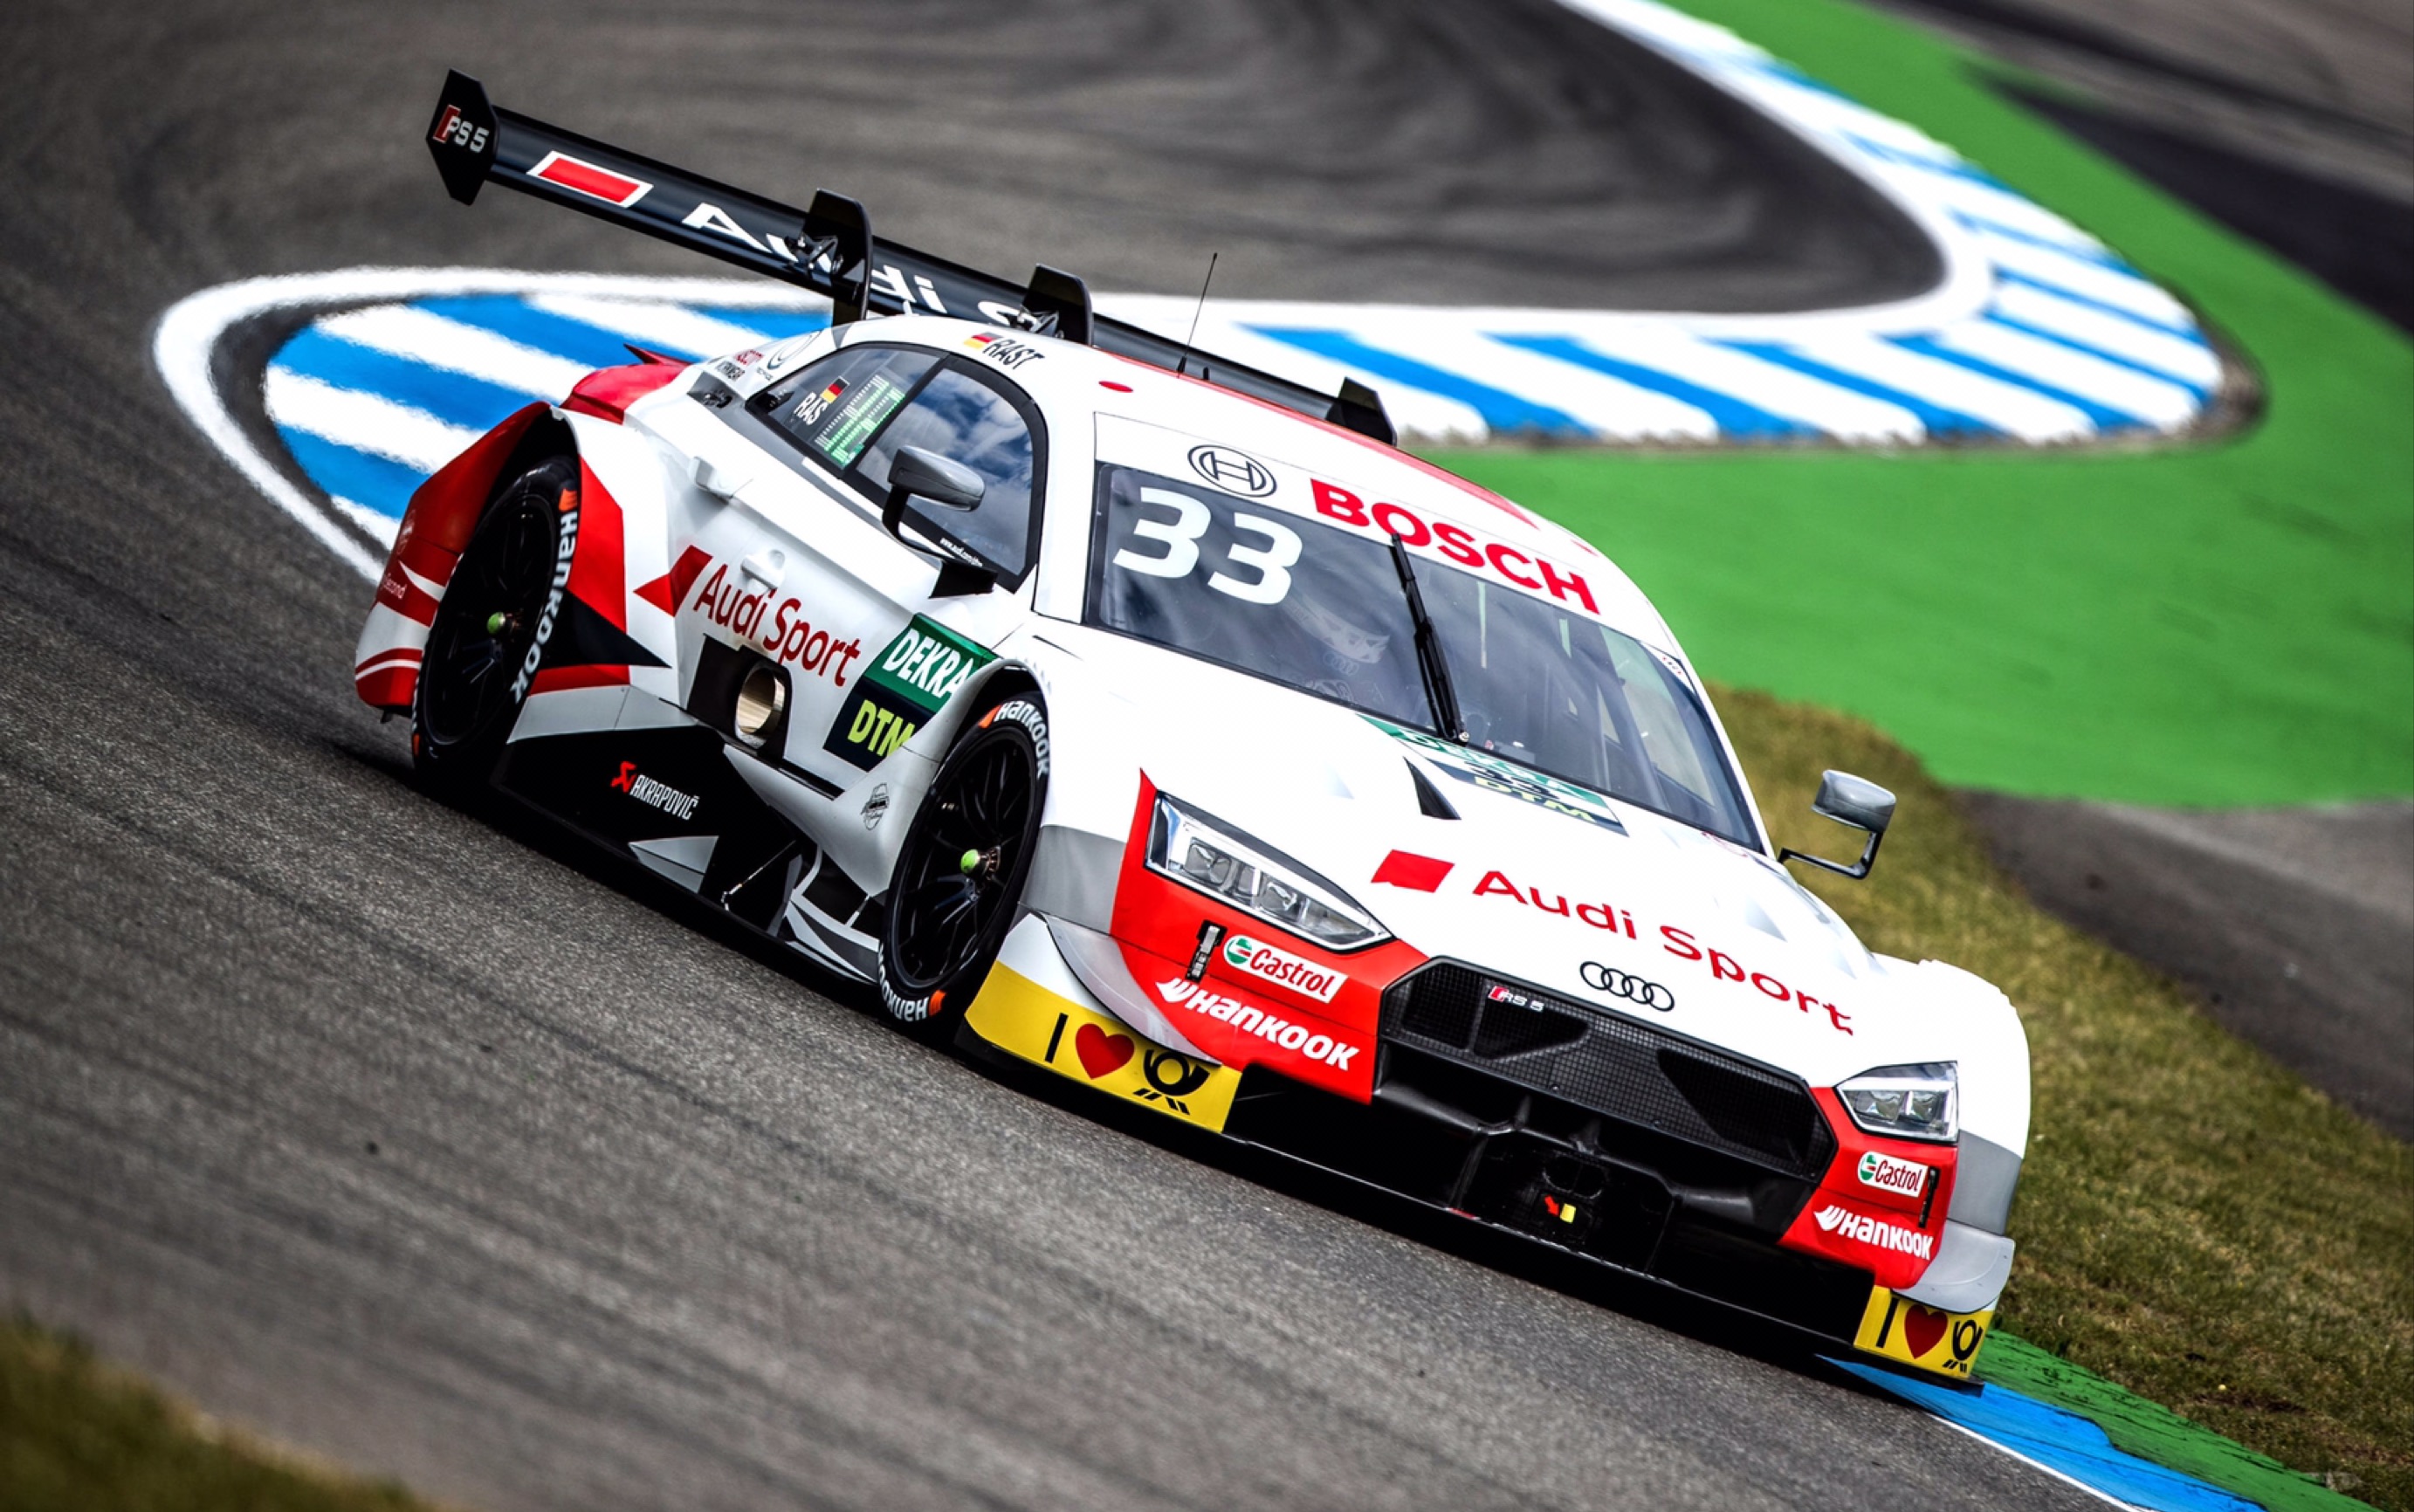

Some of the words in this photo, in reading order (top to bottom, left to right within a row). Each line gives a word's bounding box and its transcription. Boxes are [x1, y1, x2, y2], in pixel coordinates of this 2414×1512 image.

[982, 339, 1046, 370] RAST
[1112, 486, 1303, 606] 33
[1310, 478, 1600, 615] BOSCH
[693, 563, 778, 642] Audi
[762, 598, 861, 687] Sport
[882, 628, 975, 699] DEKRA
[847, 699, 916, 758] DTM
[1474, 775, 1598, 823] DTM
[1249, 948, 1337, 998] Castrol
[1472, 870, 1637, 940] Audi
[1659, 924, 1854, 1036] Sport
[1874, 1159, 1923, 1192] Castrol
